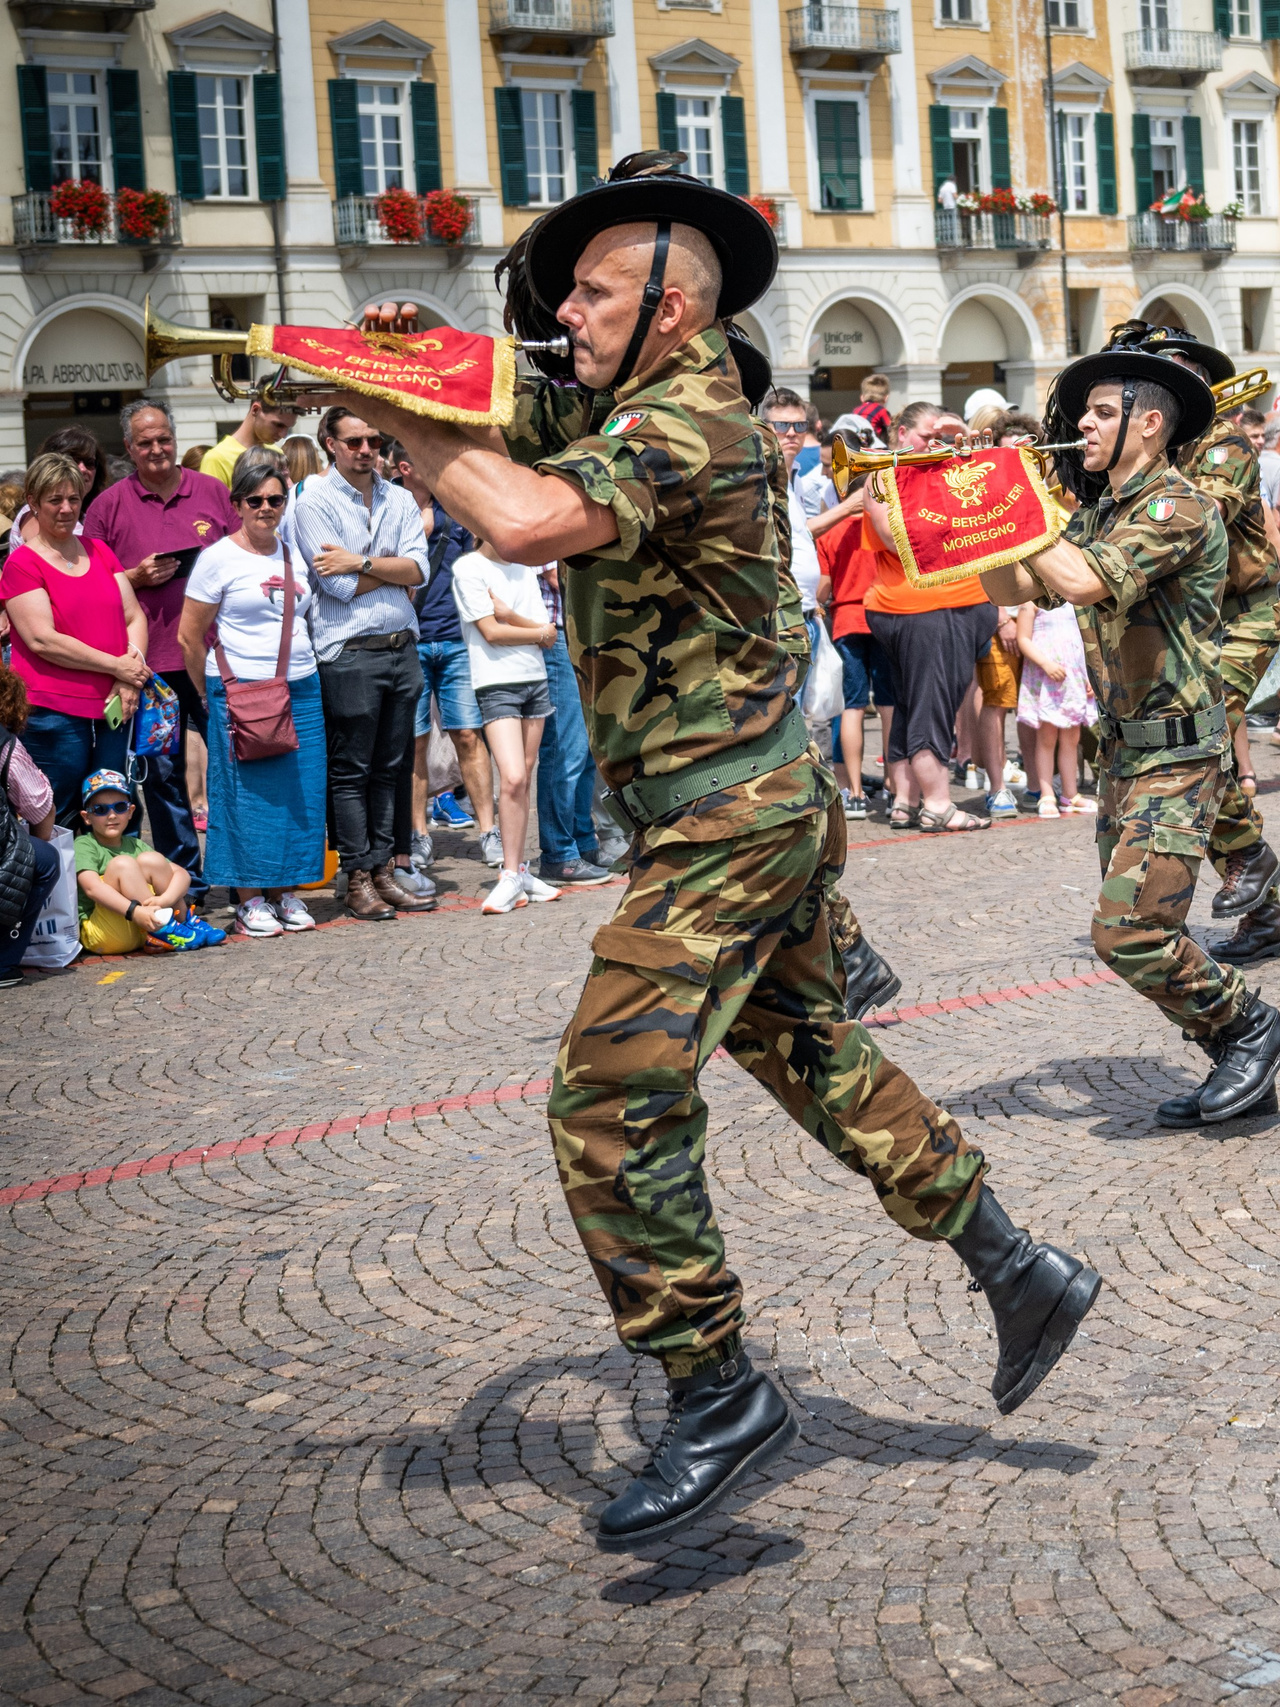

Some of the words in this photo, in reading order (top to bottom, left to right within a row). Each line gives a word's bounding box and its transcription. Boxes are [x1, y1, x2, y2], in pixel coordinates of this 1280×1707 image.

[824, 331, 863, 343] UniCredit
[825, 344, 851, 355] Banca
[52, 361, 146, 384] ABBRONZATURA
[320, 365, 443, 391] MORBEGNO
[952, 483, 1025, 528] BERSAGLIERI
[942, 522, 1016, 553] MORBEGNO
